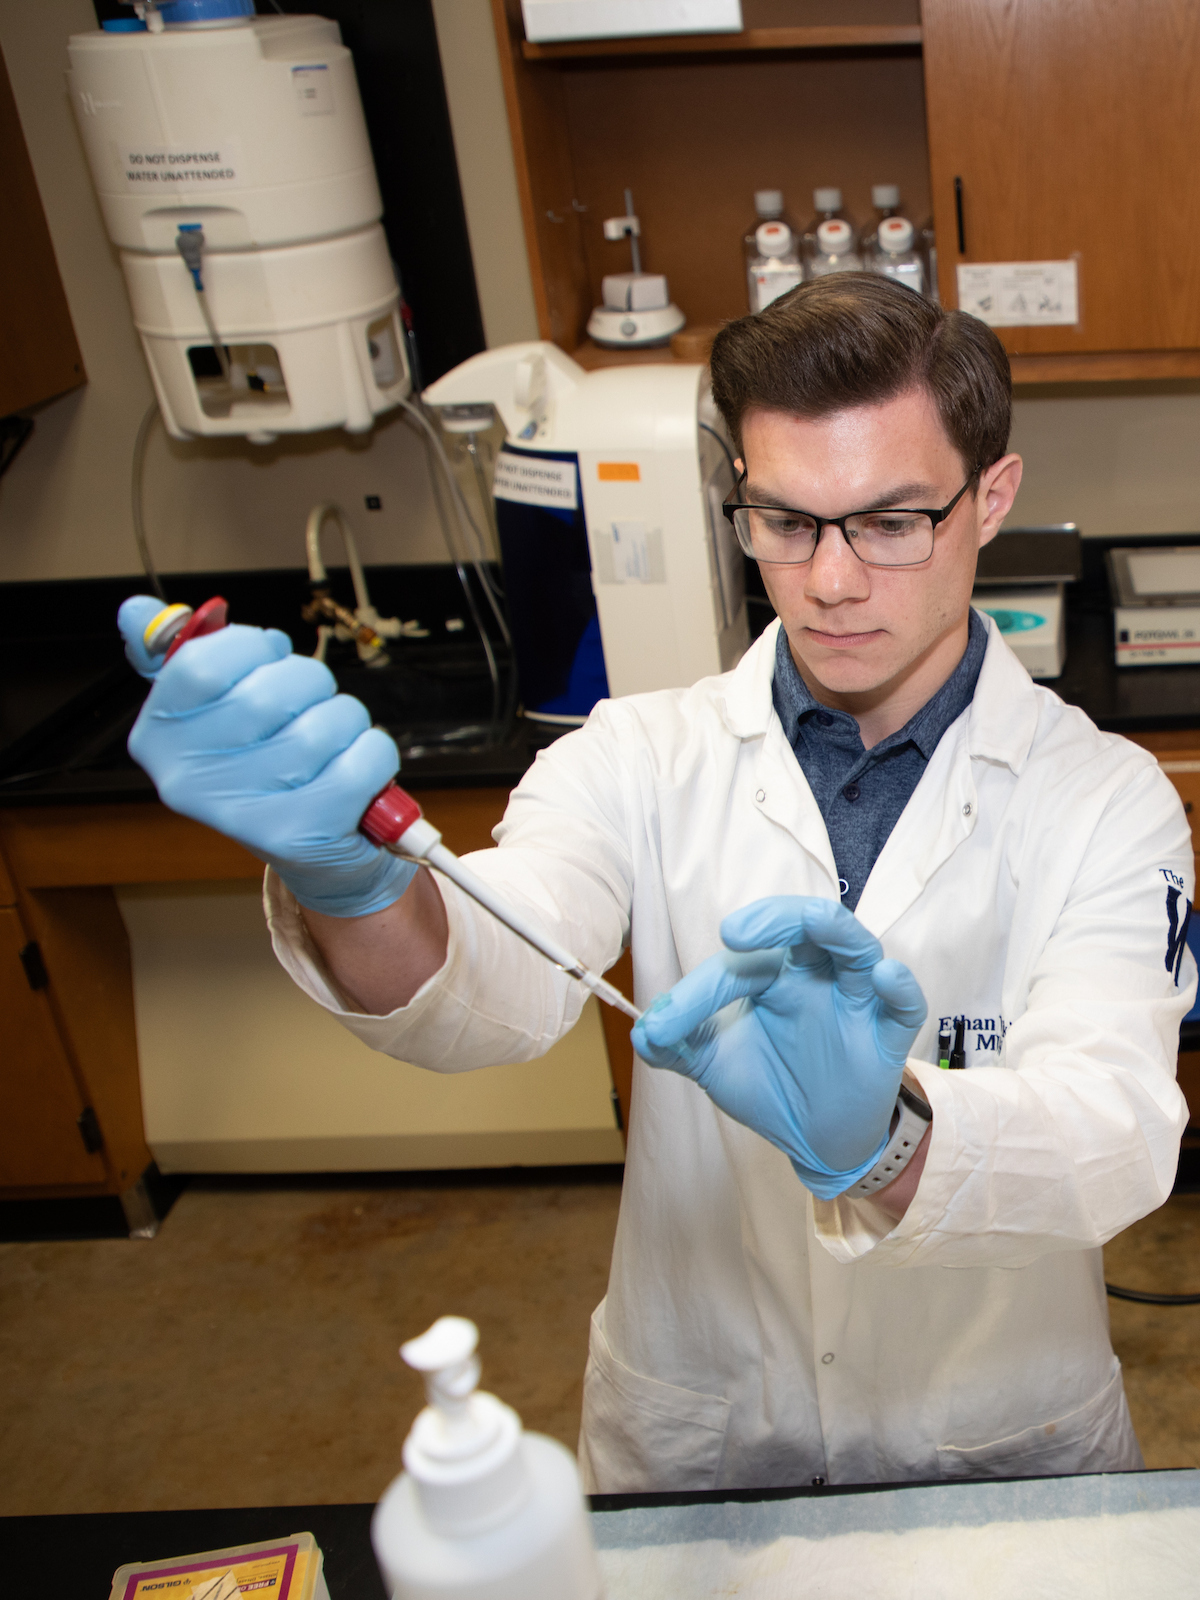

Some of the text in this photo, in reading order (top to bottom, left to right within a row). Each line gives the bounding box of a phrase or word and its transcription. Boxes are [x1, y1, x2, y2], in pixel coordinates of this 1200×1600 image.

[129, 151, 221, 165] DO NOT DISPENSE
[126, 168, 235, 181] WATER UNATTENDED
[1159, 868, 1184, 889] The
[938, 1014, 996, 1033] Ethan
[142, 1580, 182, 1591] GILSON
[247, 1580, 270, 1591] FREE
